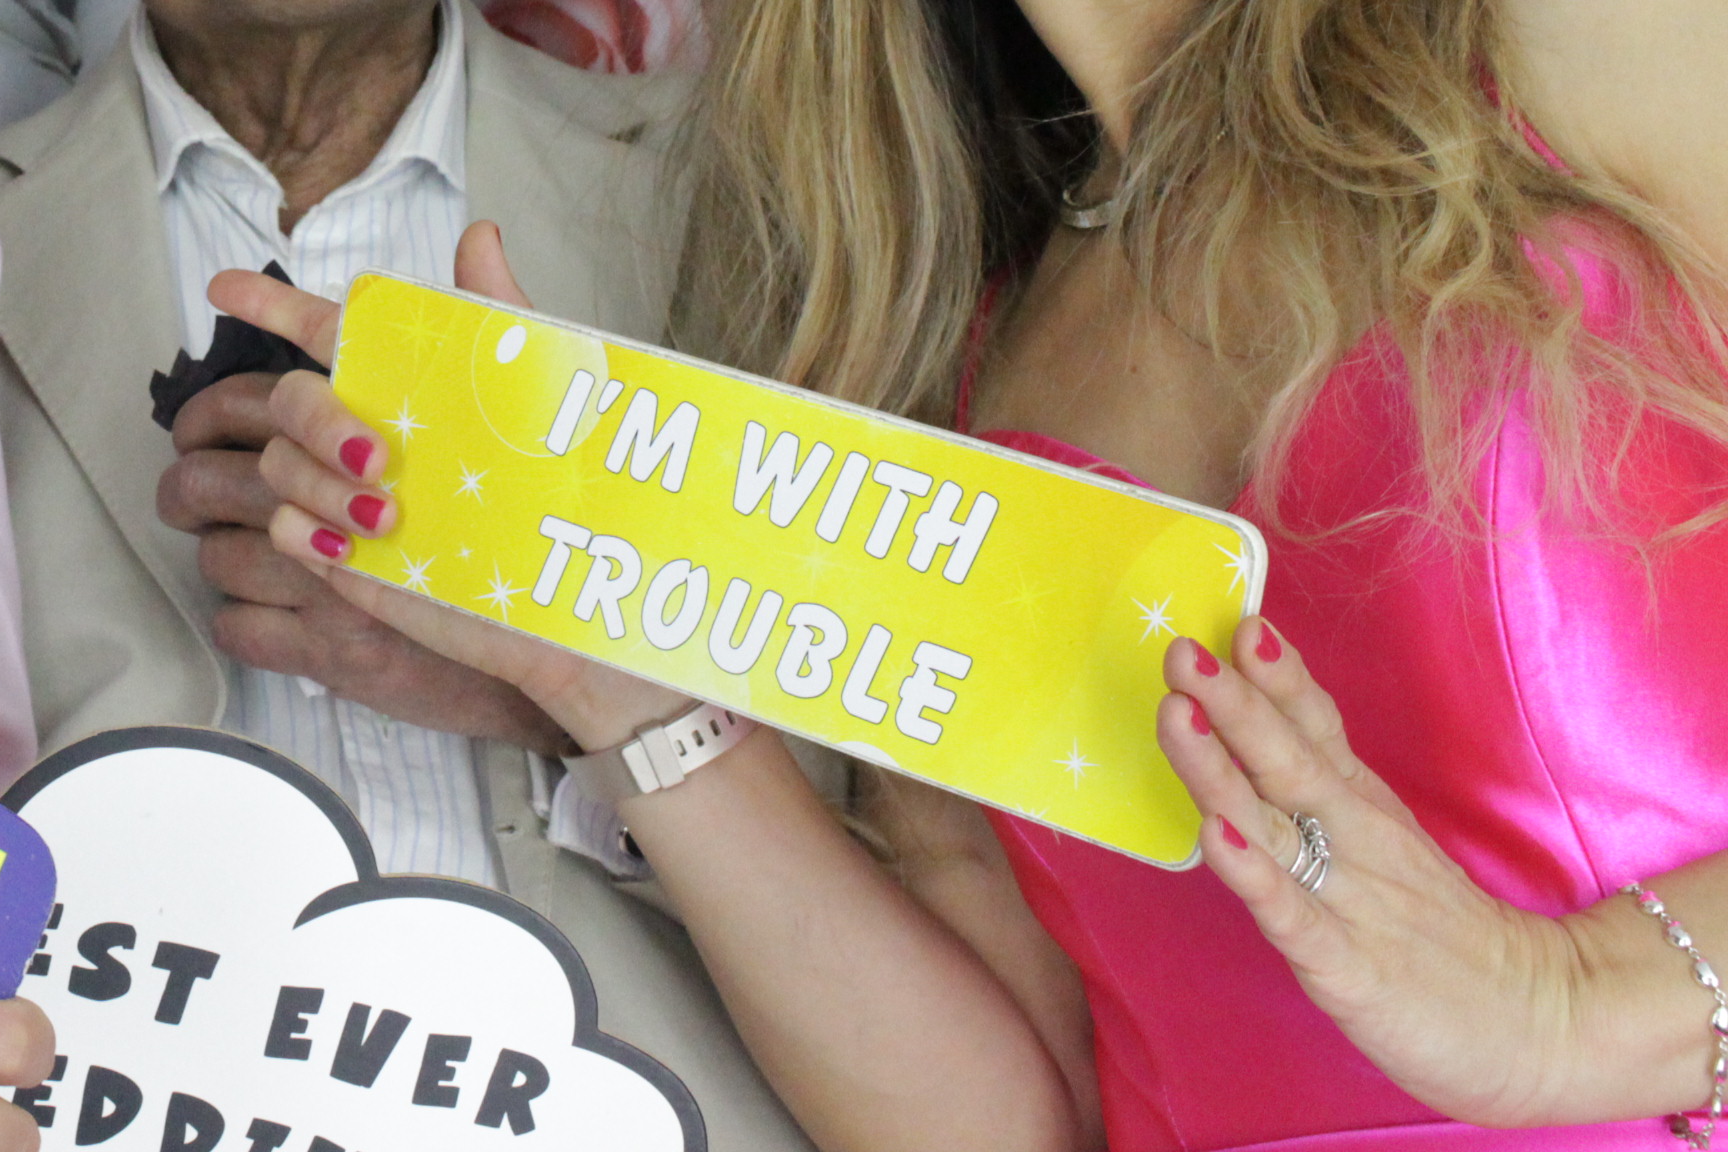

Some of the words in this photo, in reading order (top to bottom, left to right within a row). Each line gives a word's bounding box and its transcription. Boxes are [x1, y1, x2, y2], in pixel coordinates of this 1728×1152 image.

[544, 368, 702, 494] I'M
[732, 419, 1001, 586] WITH
[530, 513, 973, 745] TROUBLE
[262, 984, 551, 1136] EVER
